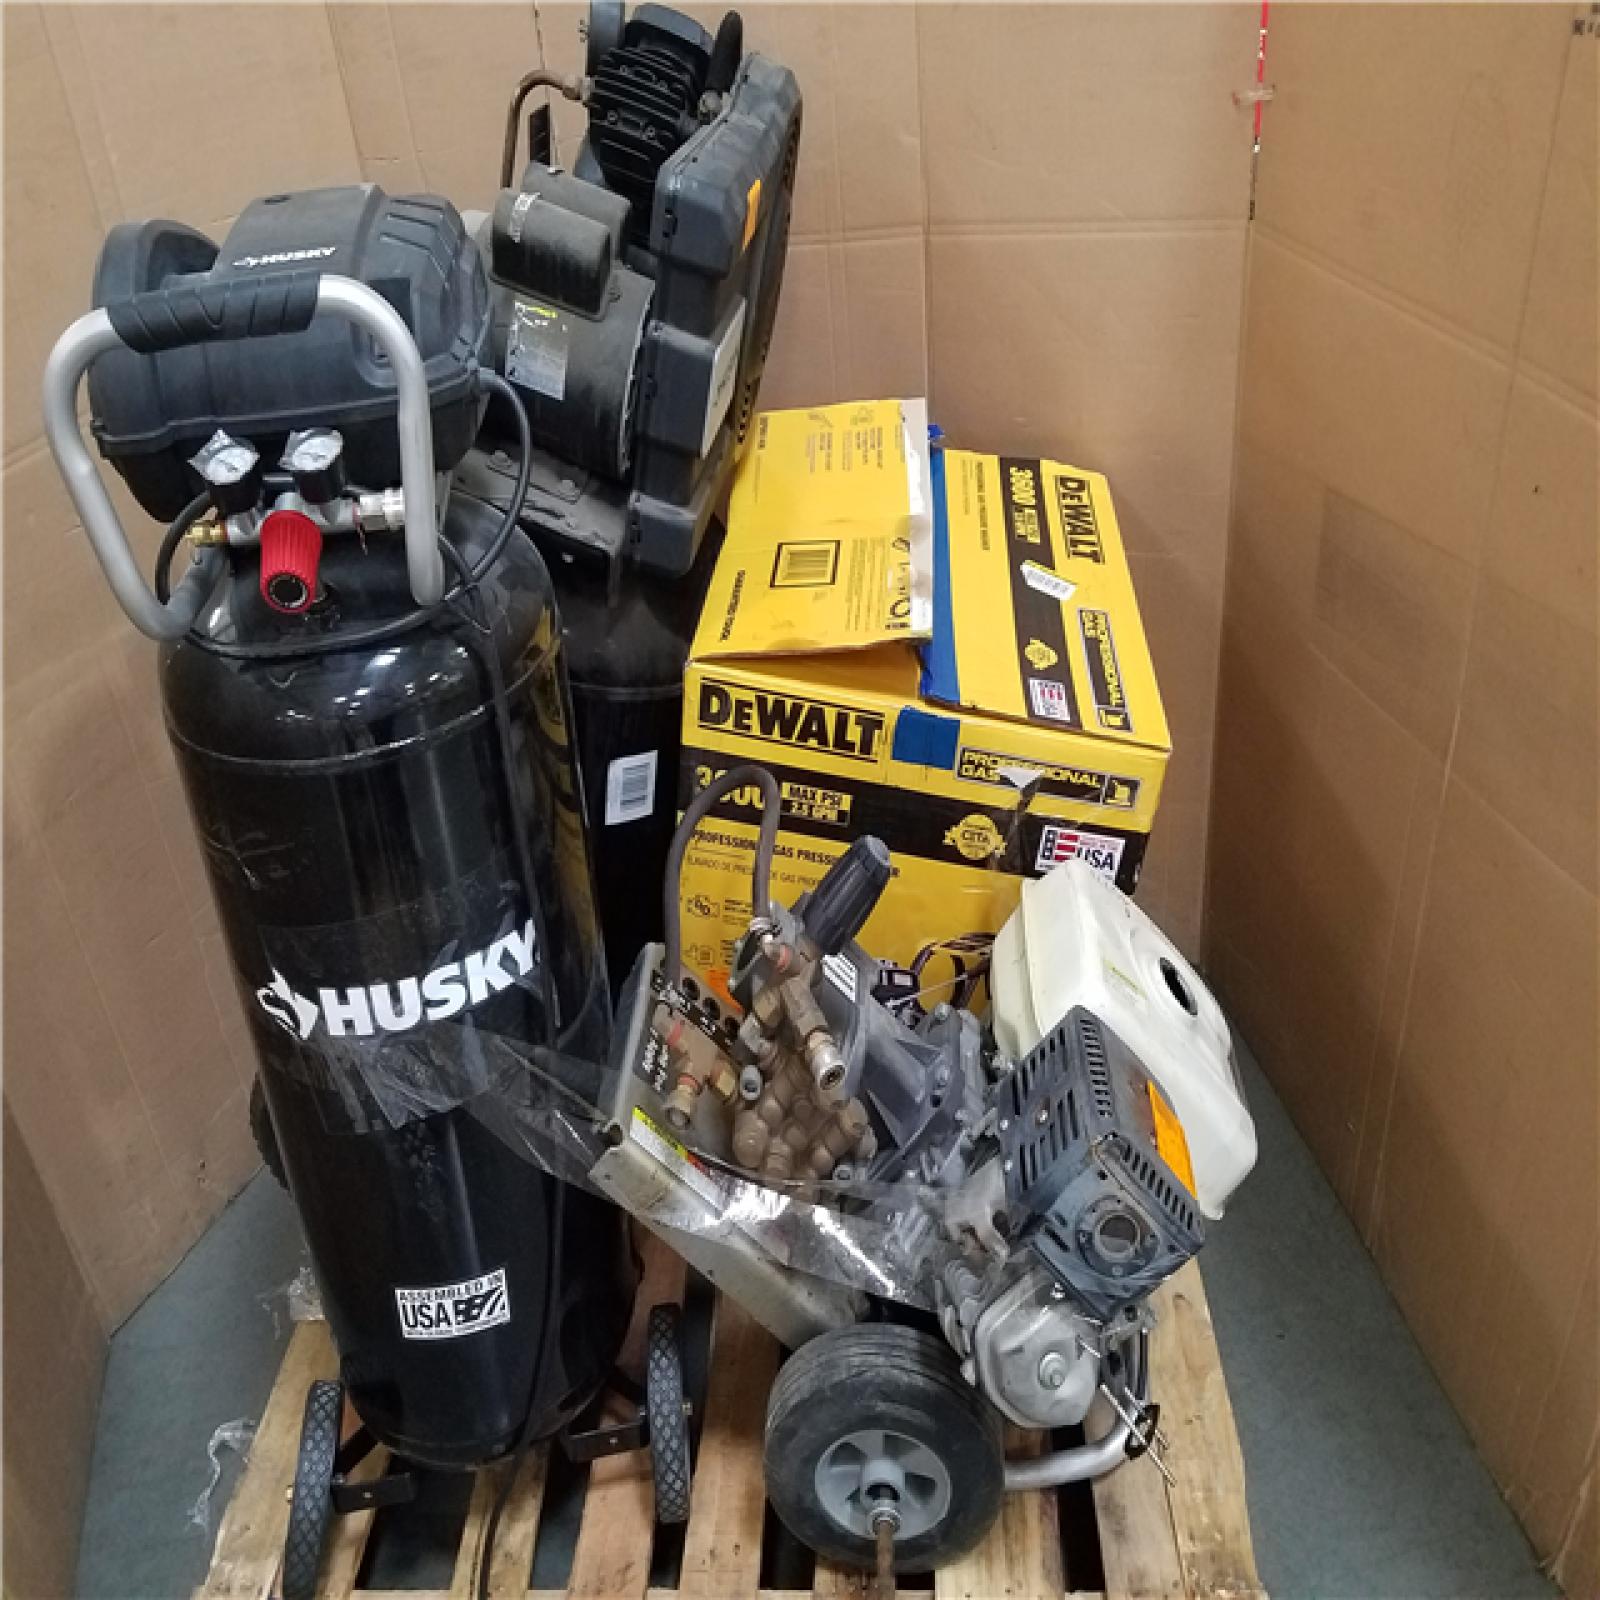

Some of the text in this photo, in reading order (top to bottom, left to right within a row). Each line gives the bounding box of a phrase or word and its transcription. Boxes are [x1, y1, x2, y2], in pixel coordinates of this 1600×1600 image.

[261, 246, 336, 266] HUSKY
[318, 918, 537, 1037] HUSKY
[402, 1303, 452, 1328] USA
